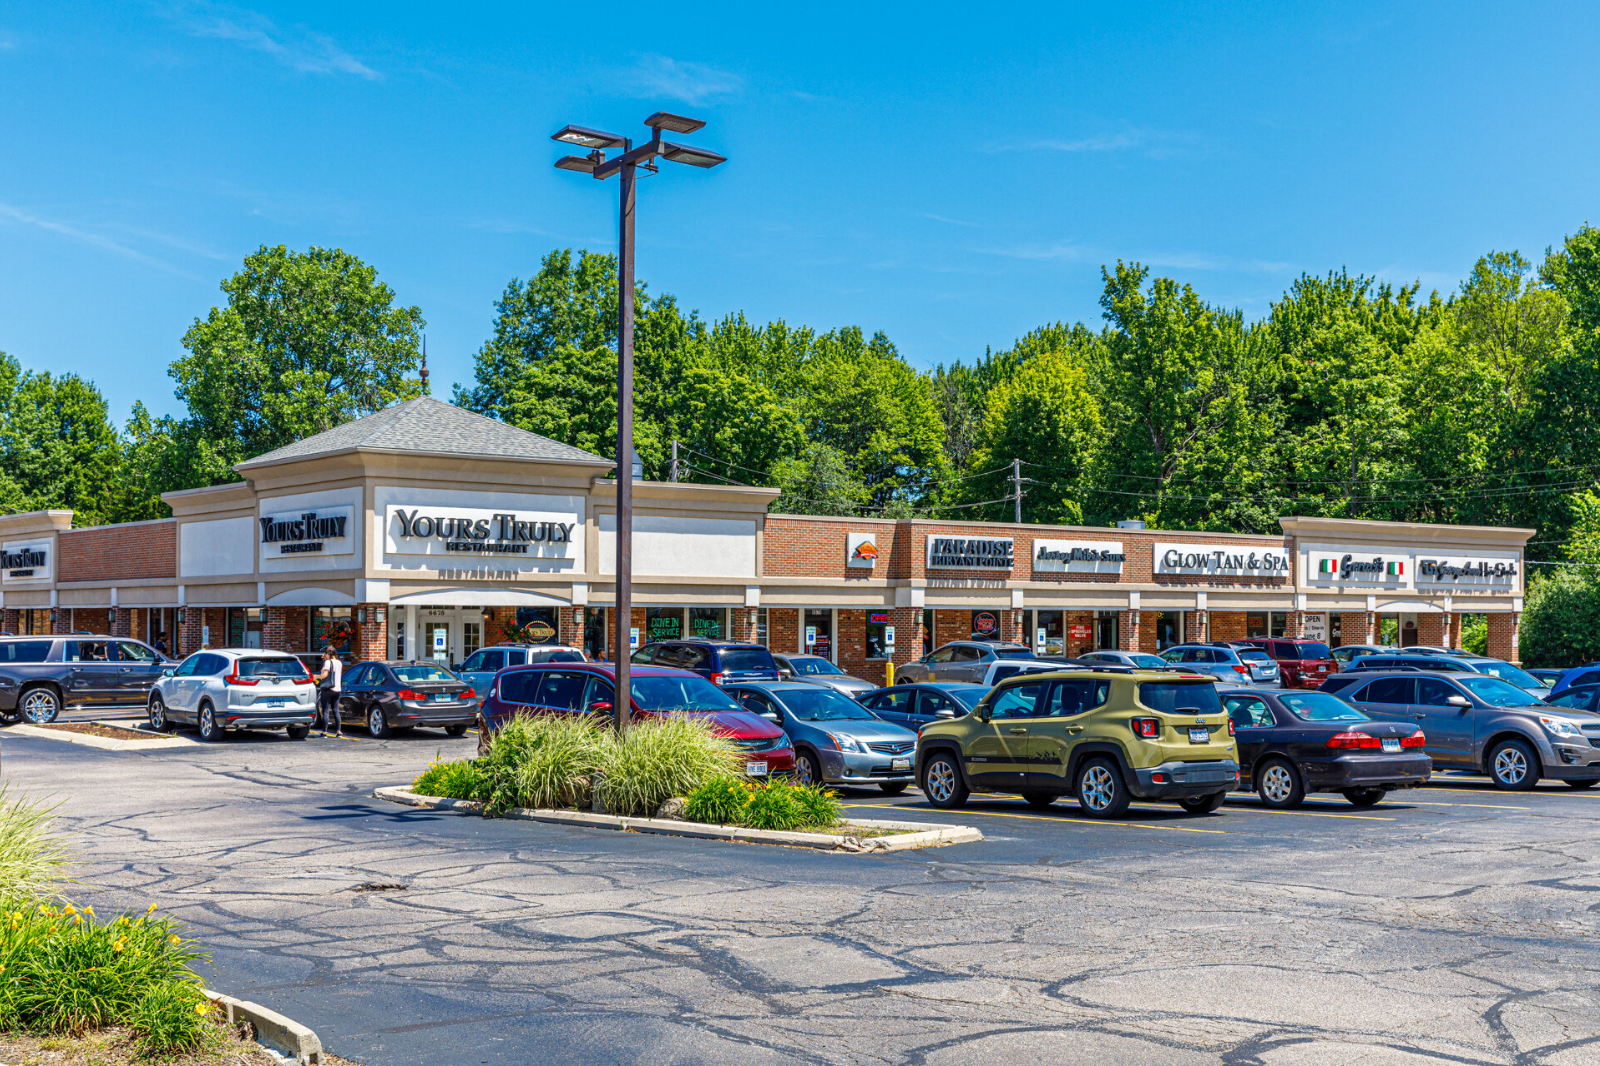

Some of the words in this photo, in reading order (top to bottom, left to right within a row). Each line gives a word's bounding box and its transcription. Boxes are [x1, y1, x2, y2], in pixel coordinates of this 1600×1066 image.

[260, 517, 303, 543] YOURS
[302, 513, 346, 540] TRULY
[395, 509, 491, 540] YOURS
[493, 513, 576, 543] TRULY
[446, 541, 530, 554] RESTAURANT
[934, 539, 1014, 556] PARADISE
[977, 557, 1015, 568] POINTE
[1164, 549, 1210, 568] GLOW
[1213, 550, 1244, 570] TAN
[1246, 551, 1261, 569] &
[1263, 552, 1289, 571] SPA
